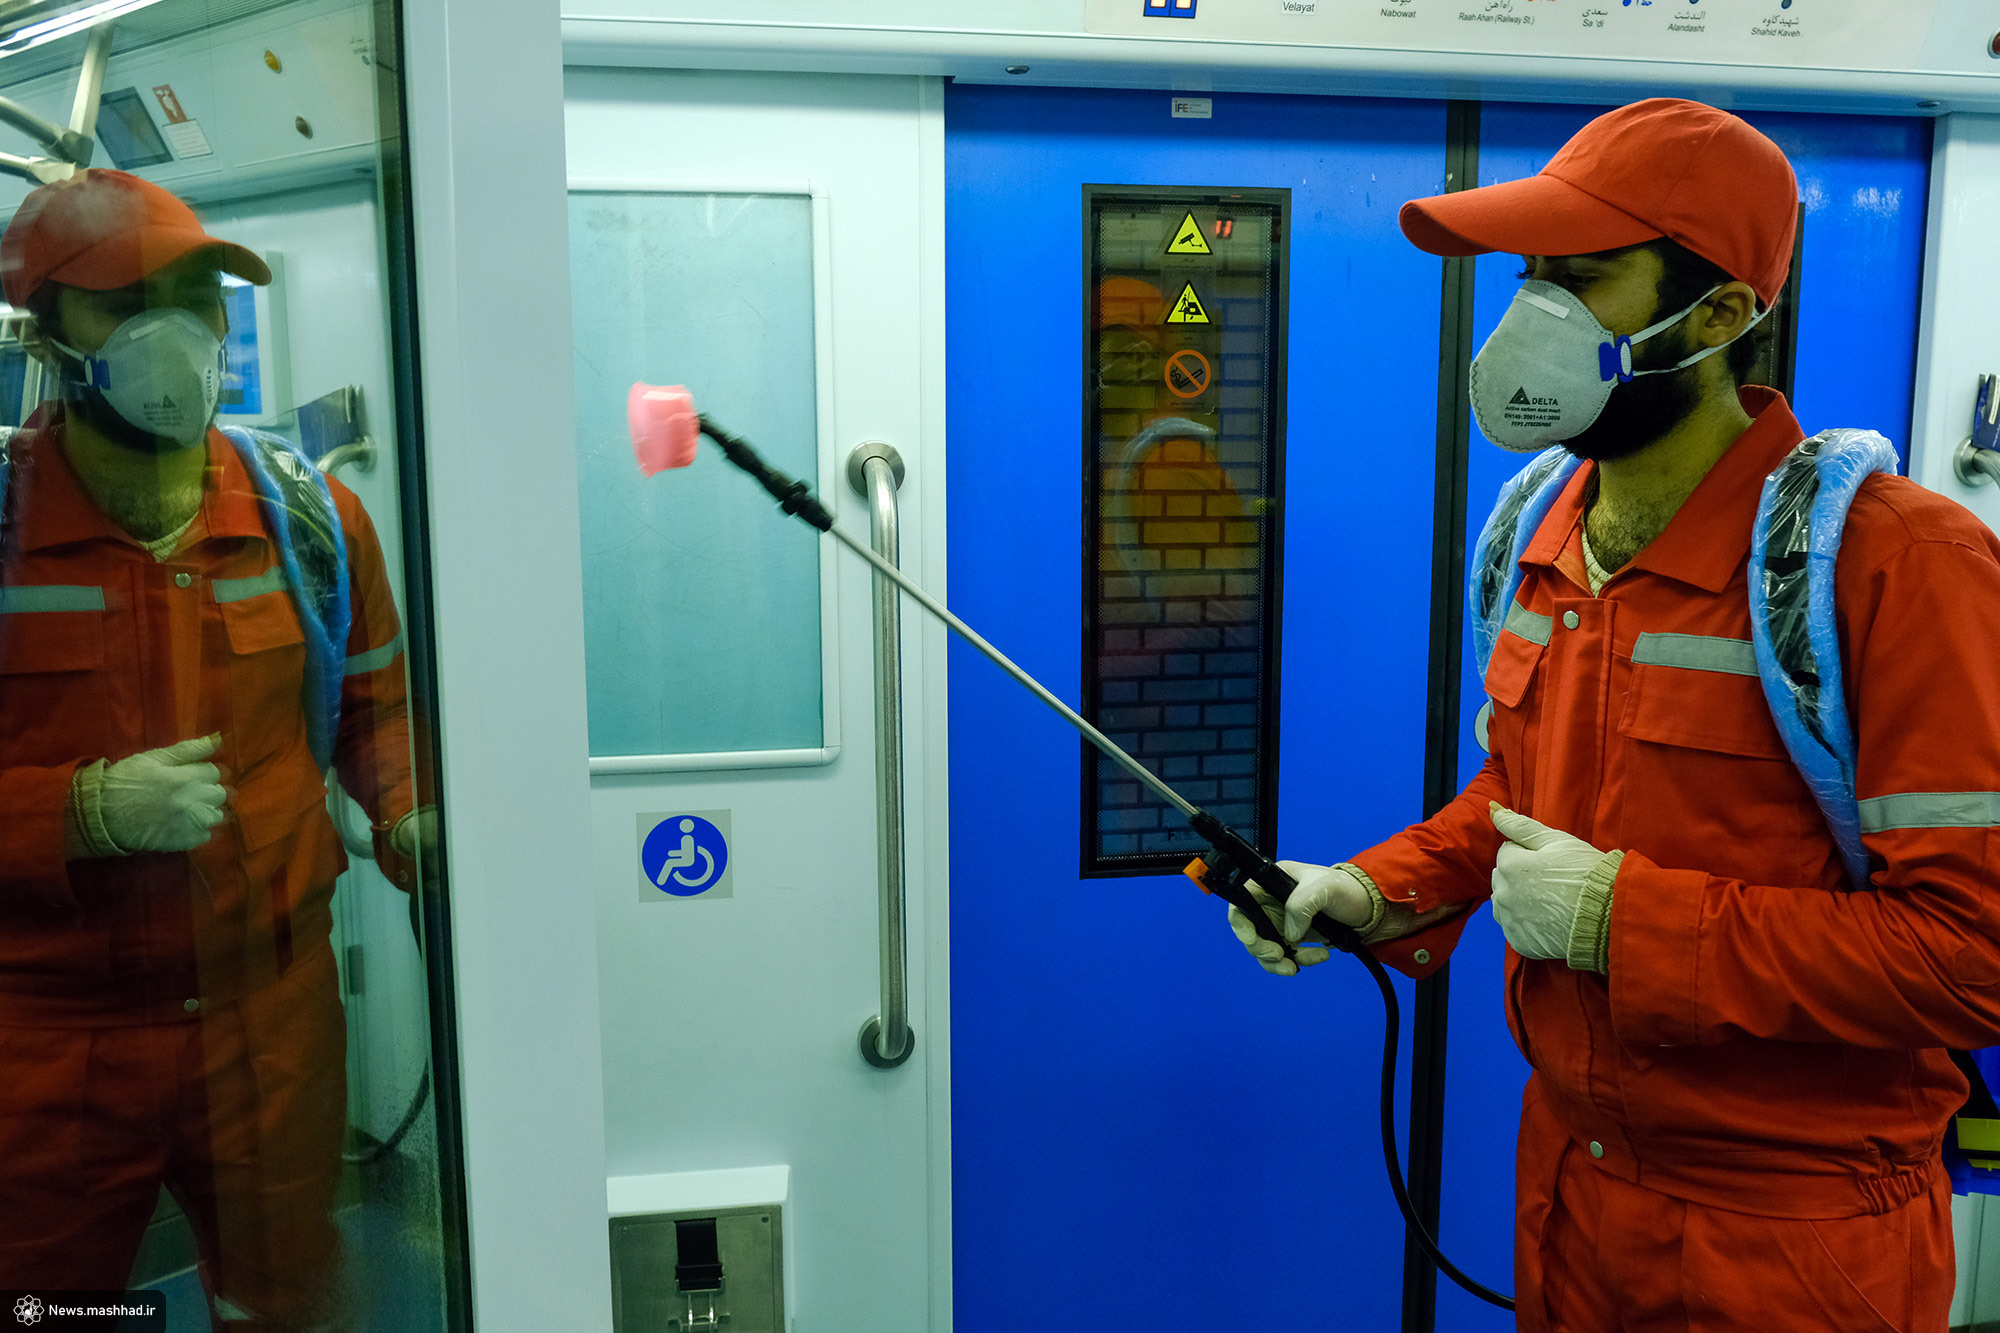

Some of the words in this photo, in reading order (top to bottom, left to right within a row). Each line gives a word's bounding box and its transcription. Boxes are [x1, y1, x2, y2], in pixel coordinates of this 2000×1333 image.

[1283, 1, 1315, 14] Velayat
[1380, 8, 1417, 19] Nabowat
[1458, 12, 1476, 22] Raah
[1476, 13, 1494, 22] Ahan
[1494, 14, 1522, 26] (Railway
[1667, 23, 1706, 33] Alandasht
[1751, 27, 1777, 37] Shahid
[1777, 28, 1801, 38] Kaveh
[1532, 397, 1559, 406] DELTA
